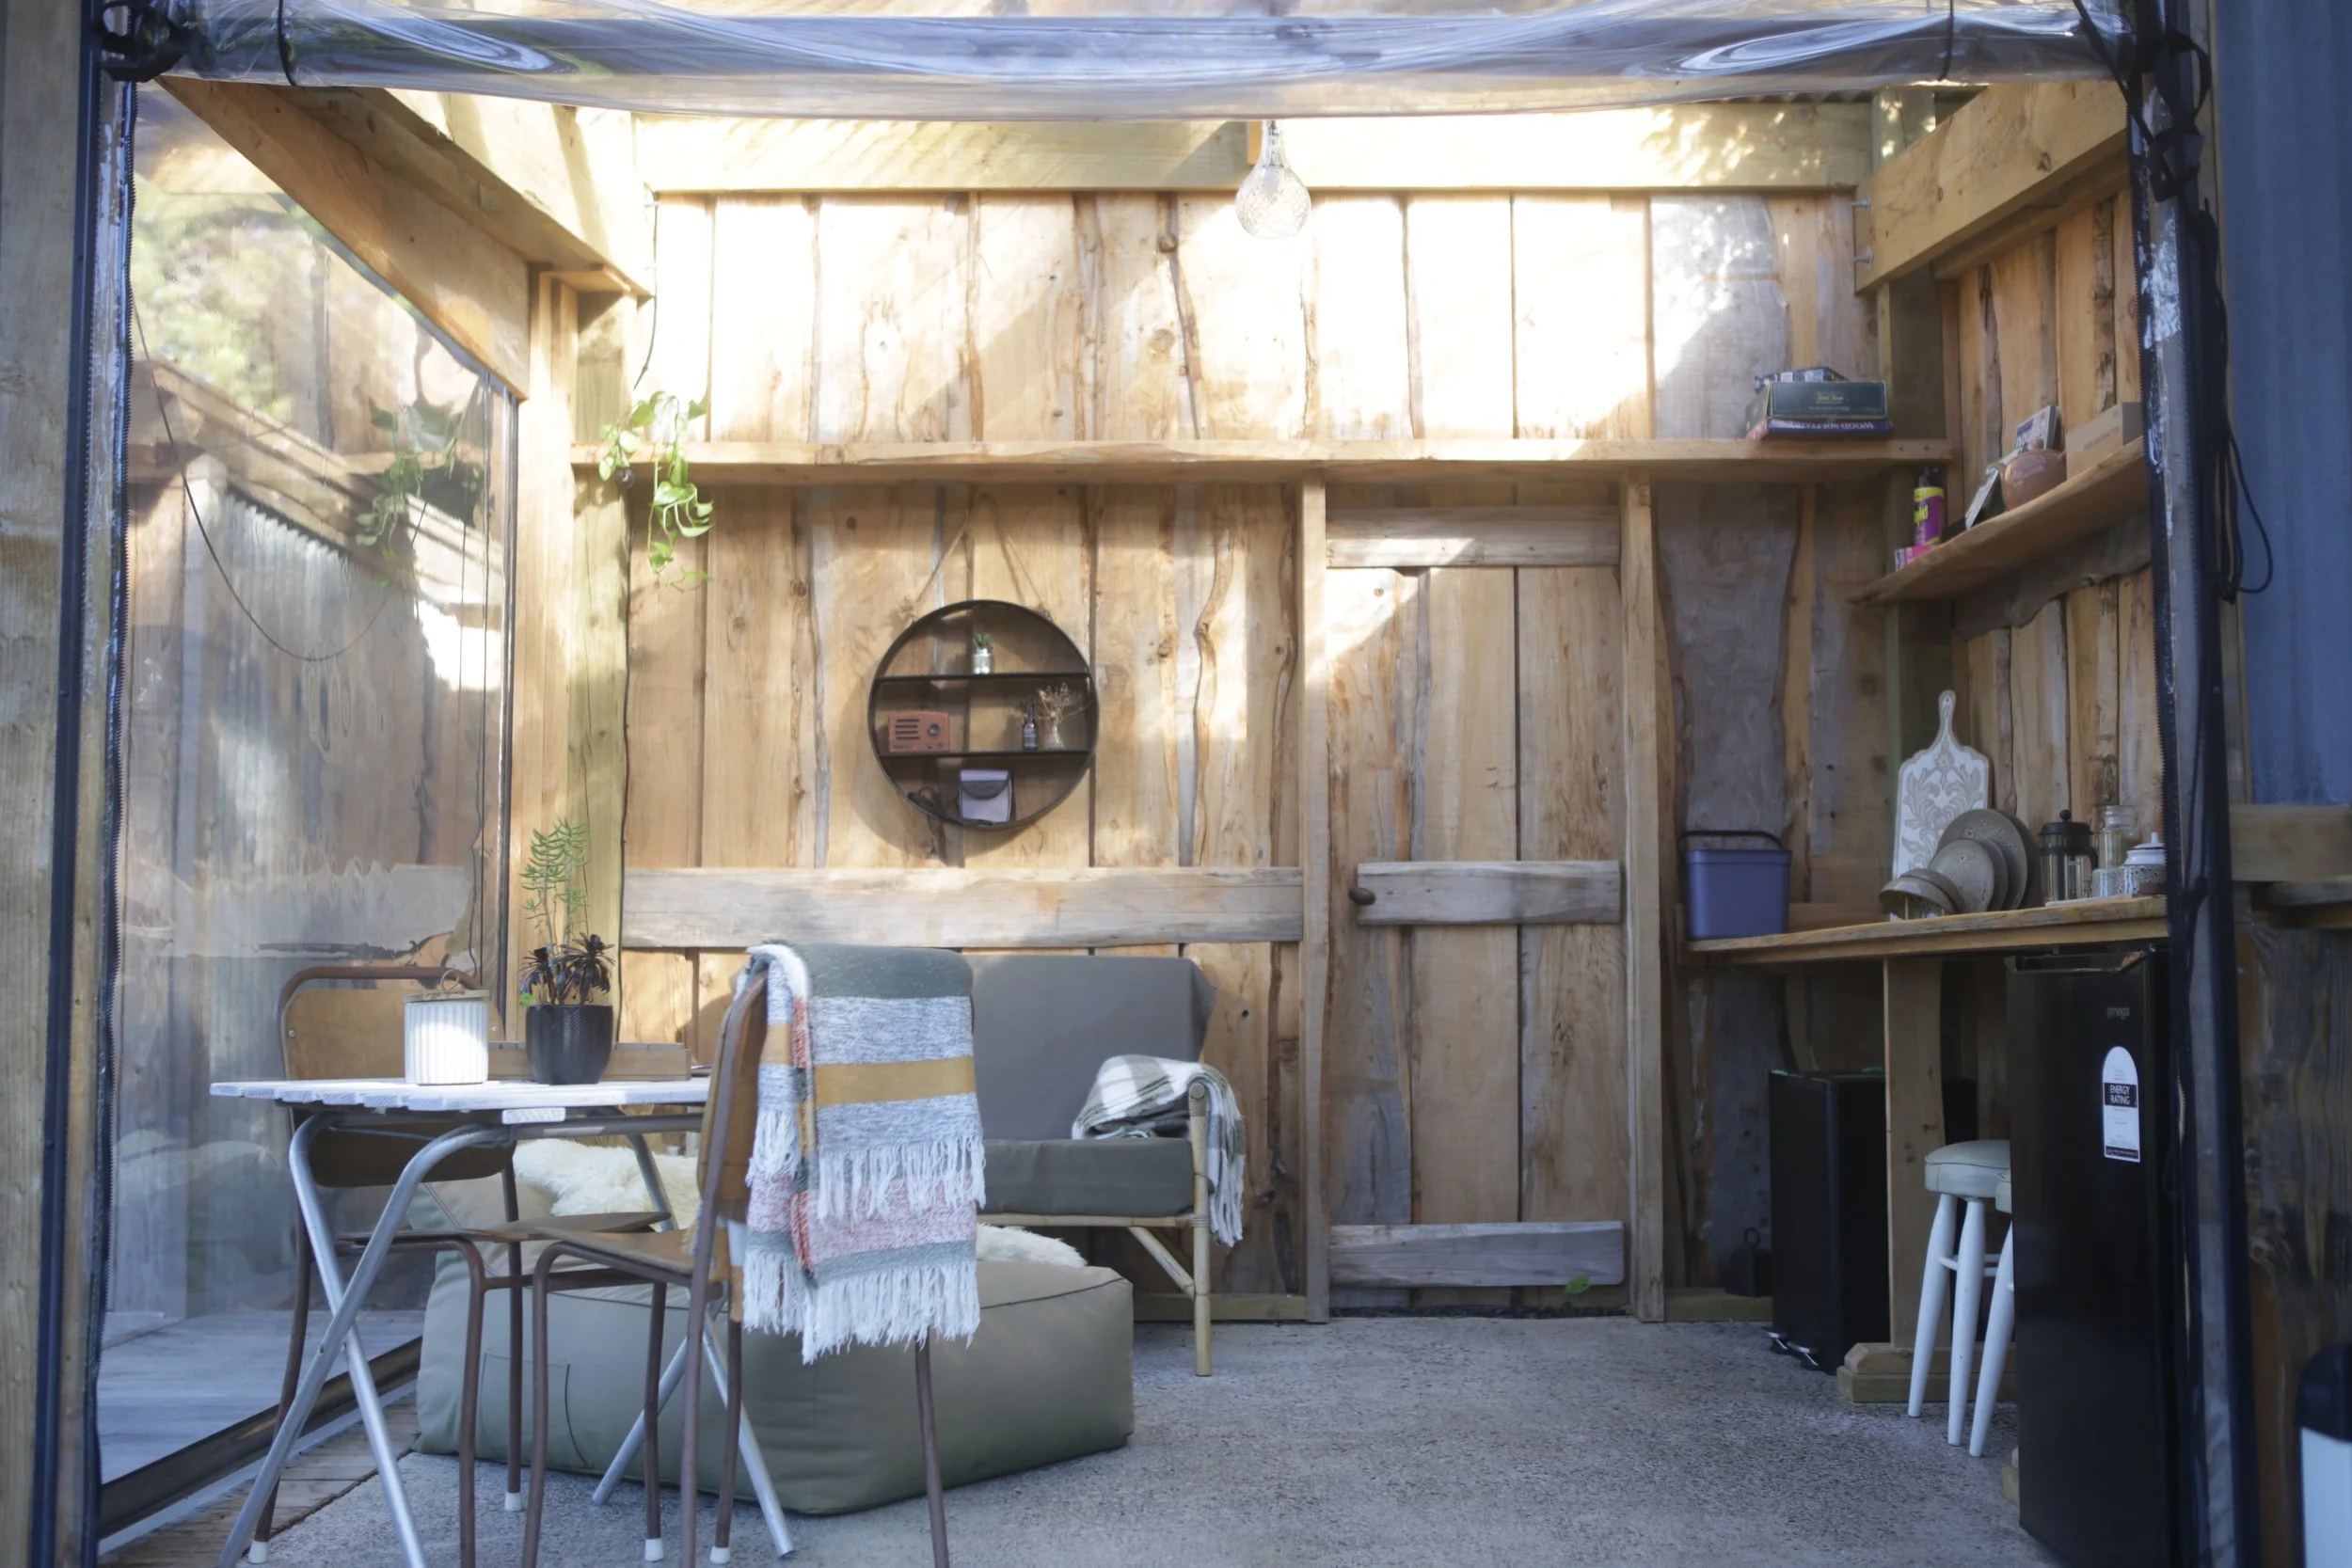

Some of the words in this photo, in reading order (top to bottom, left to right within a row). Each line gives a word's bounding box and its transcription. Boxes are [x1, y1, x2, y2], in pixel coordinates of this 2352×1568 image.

[1842, 421, 1875, 430] WOOD
[2109, 1085, 2131, 1094] ENERGY
[2110, 1095, 2131, 1105] RATING
